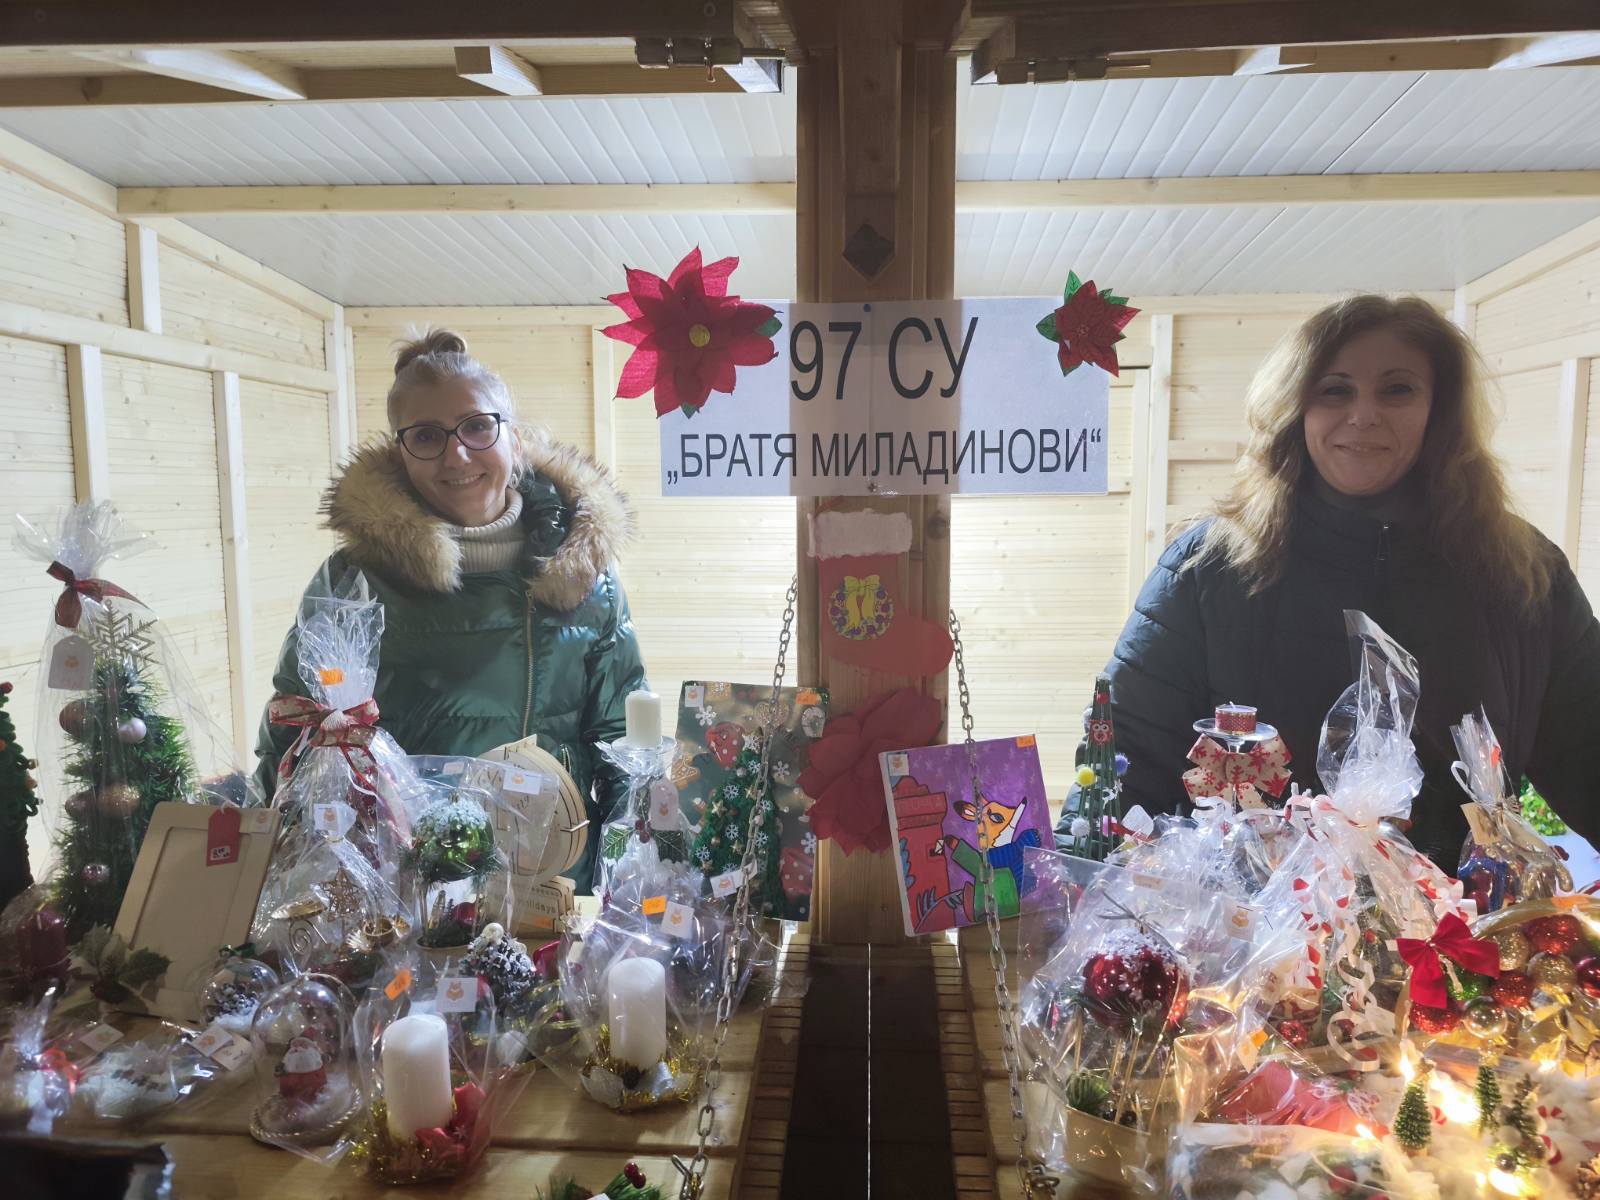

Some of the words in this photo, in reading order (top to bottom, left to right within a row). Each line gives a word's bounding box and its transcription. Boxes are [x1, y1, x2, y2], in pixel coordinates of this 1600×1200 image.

[789, 320, 862, 401] 97
[888, 316, 979, 399] СУ
[667, 433, 797, 485] „БРАТЯ
[811, 427, 1102, 485] МИЛАДИНОВИ“
